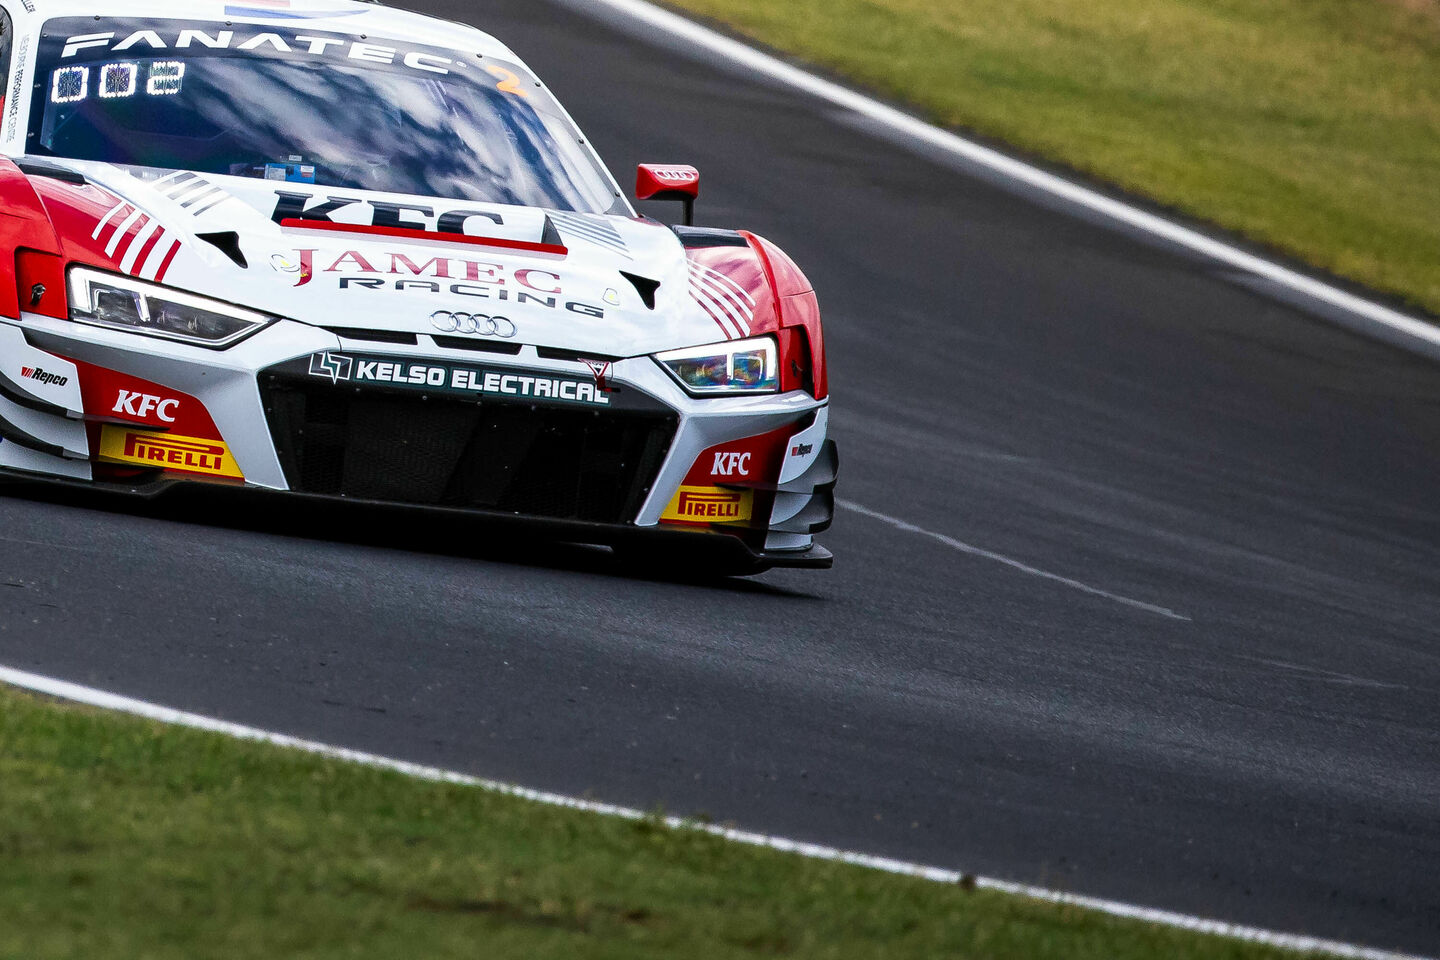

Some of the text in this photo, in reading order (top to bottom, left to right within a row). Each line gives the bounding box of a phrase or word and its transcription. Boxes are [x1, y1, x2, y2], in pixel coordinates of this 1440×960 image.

[61, 29, 454, 74] FANATEC
[51, 61, 185, 104] 002
[271, 189, 504, 236] KFC
[292, 248, 562, 294] JAMEC
[339, 277, 604, 319] RACING
[30, 367, 68, 387] Repco
[356, 361, 609, 404] KELSO ELECTRICAL
[112, 389, 180, 422] KFC
[124, 432, 224, 470] PIRELLI
[710, 452, 751, 475] KFC
[677, 491, 741, 517] PIRELLI
